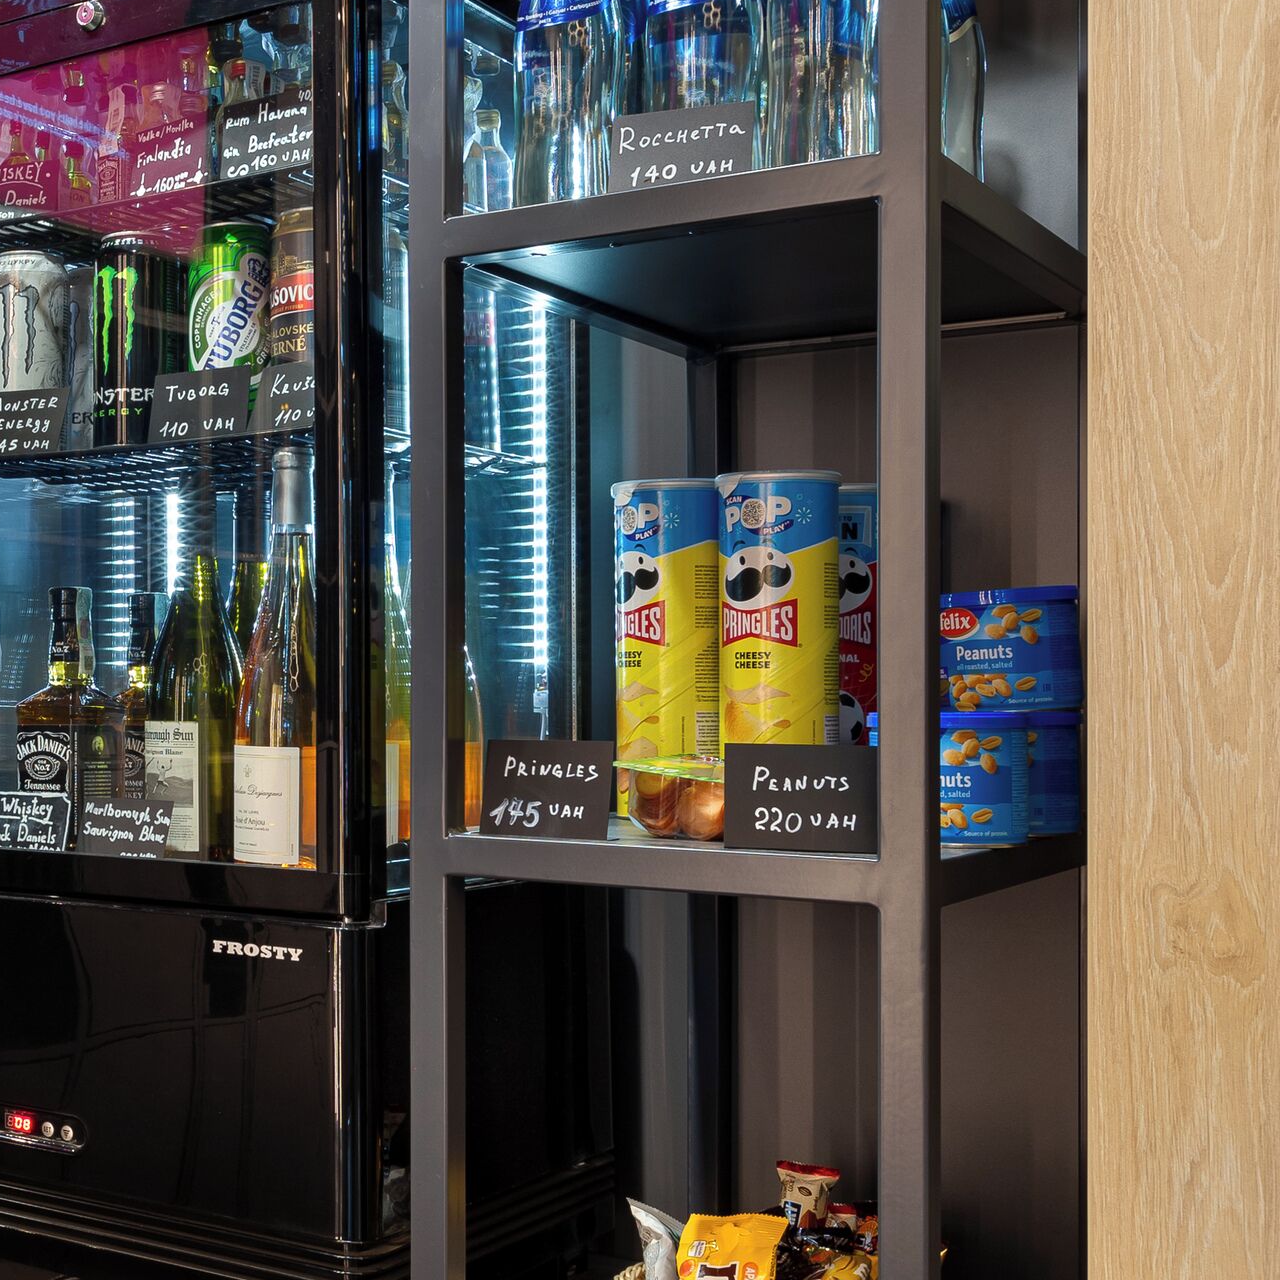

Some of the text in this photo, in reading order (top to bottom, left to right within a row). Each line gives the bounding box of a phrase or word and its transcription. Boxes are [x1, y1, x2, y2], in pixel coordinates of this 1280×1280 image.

[257, 102, 308, 124] Havana
[248, 124, 313, 154] Beefeater
[137, 137, 192, 169] Finlandia
[251, 148, 311, 171] 160 UAH
[630, 158, 734, 187] 140 UAH
[153, 176, 174, 193] 160
[4, 190, 48, 207] Daniels
[204, 279, 264, 370] TUBORG
[271, 334, 308, 357] ERNÉ
[166, 382, 230, 402] TUBORG
[160, 416, 236, 438] 110 UAH
[23, 438, 50, 450] UAH
[722, 604, 795, 642] PRINGLES
[734, 651, 772, 661] CHEESY
[957, 644, 1014, 662] Peanuts
[734, 660, 772, 670] CHEESE
[991, 660, 1013, 670] salted
[173, 728, 194, 741] Sun
[16, 734, 73, 762] JACK DANIEL'S
[504, 755, 599, 782] PRINGLES
[752, 766, 850, 792] PEANUTS
[24, 779, 61, 791] Tennessee
[948, 789, 971, 799] salted
[0, 797, 54, 821] Whiskey
[85, 801, 171, 826] Marlborough Sun
[549, 803, 584, 819] UAH
[755, 807, 857, 833] 220 UAH
[17, 823, 57, 845] Daniels
[83, 821, 167, 844] Sauvignon Blanc
[213, 939, 304, 962] FROSTY
